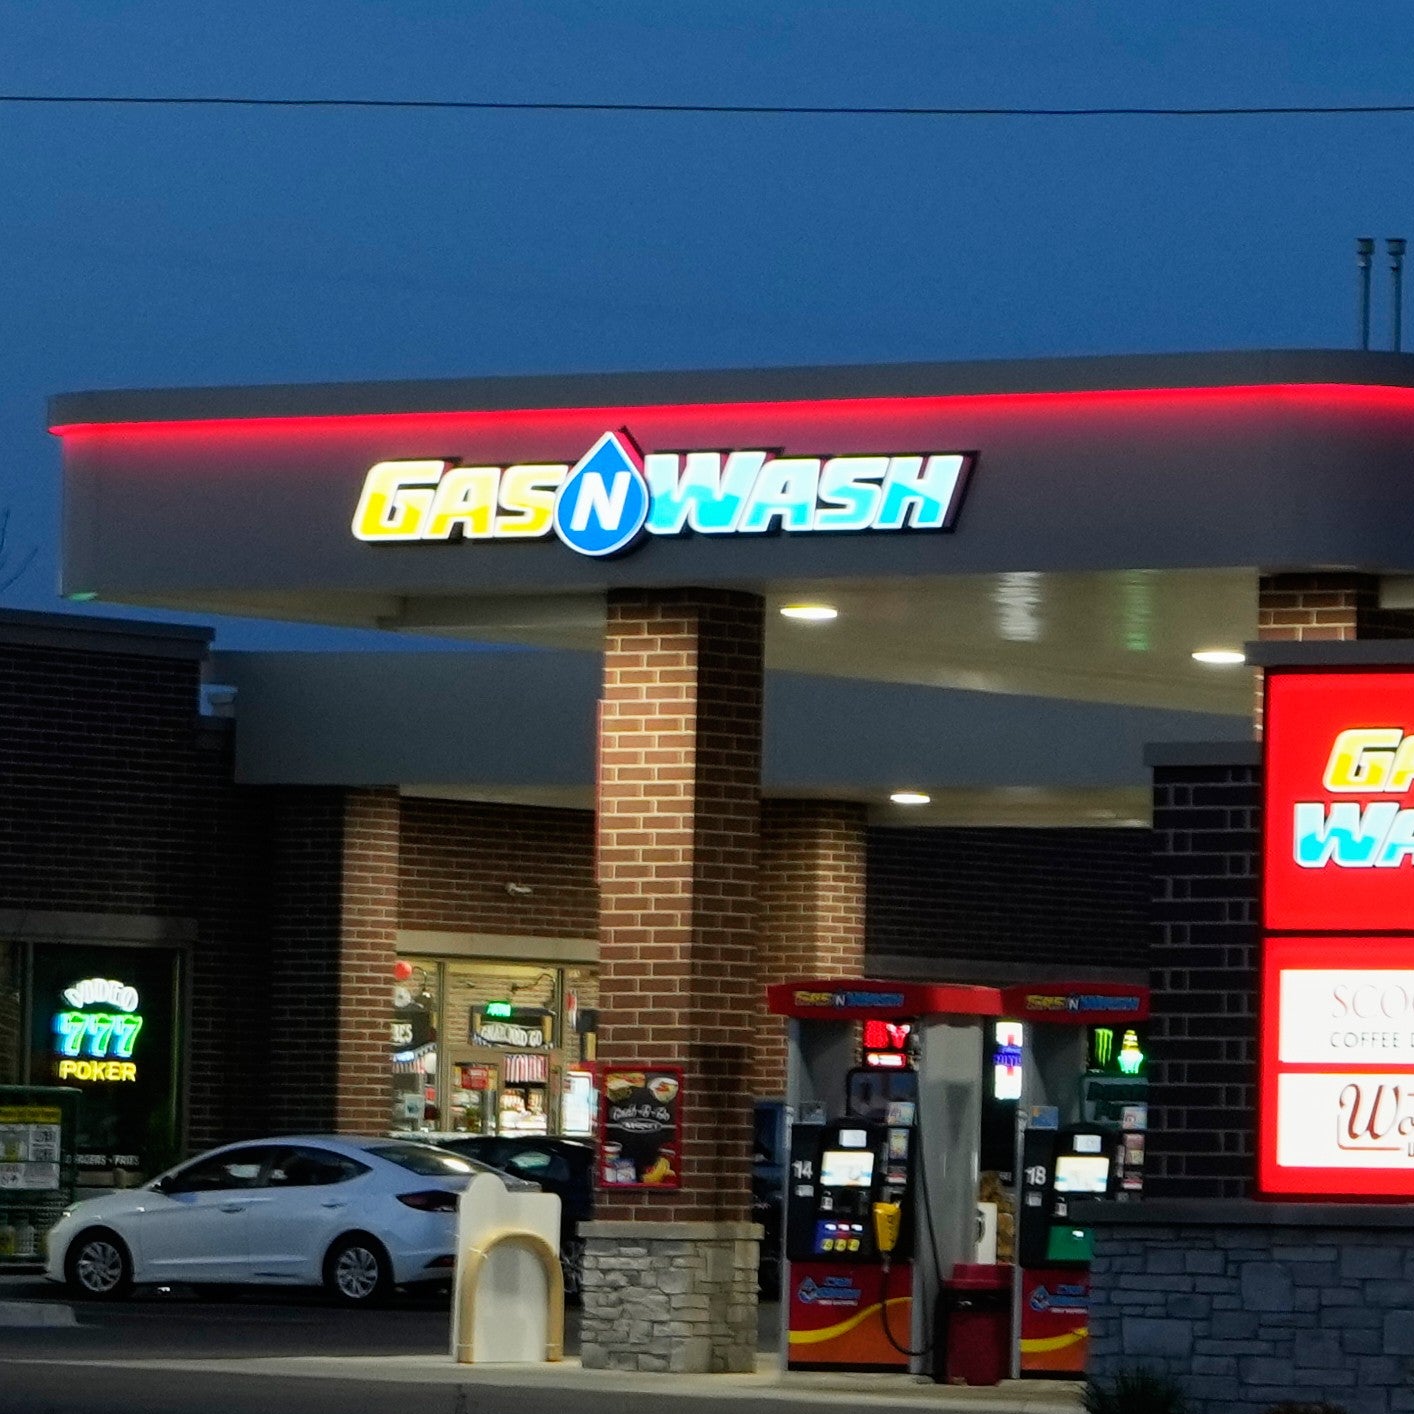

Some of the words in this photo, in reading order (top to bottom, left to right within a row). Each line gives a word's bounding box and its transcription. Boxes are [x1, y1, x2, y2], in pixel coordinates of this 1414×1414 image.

[351, 459, 568, 541] GAS
[644, 450, 965, 535] WASH
[1330, 1031, 1400, 1049] COFFEE
[59, 1060, 137, 1082] POKER
[791, 1160, 814, 1179] 14
[1024, 1165, 1047, 1185] 18
